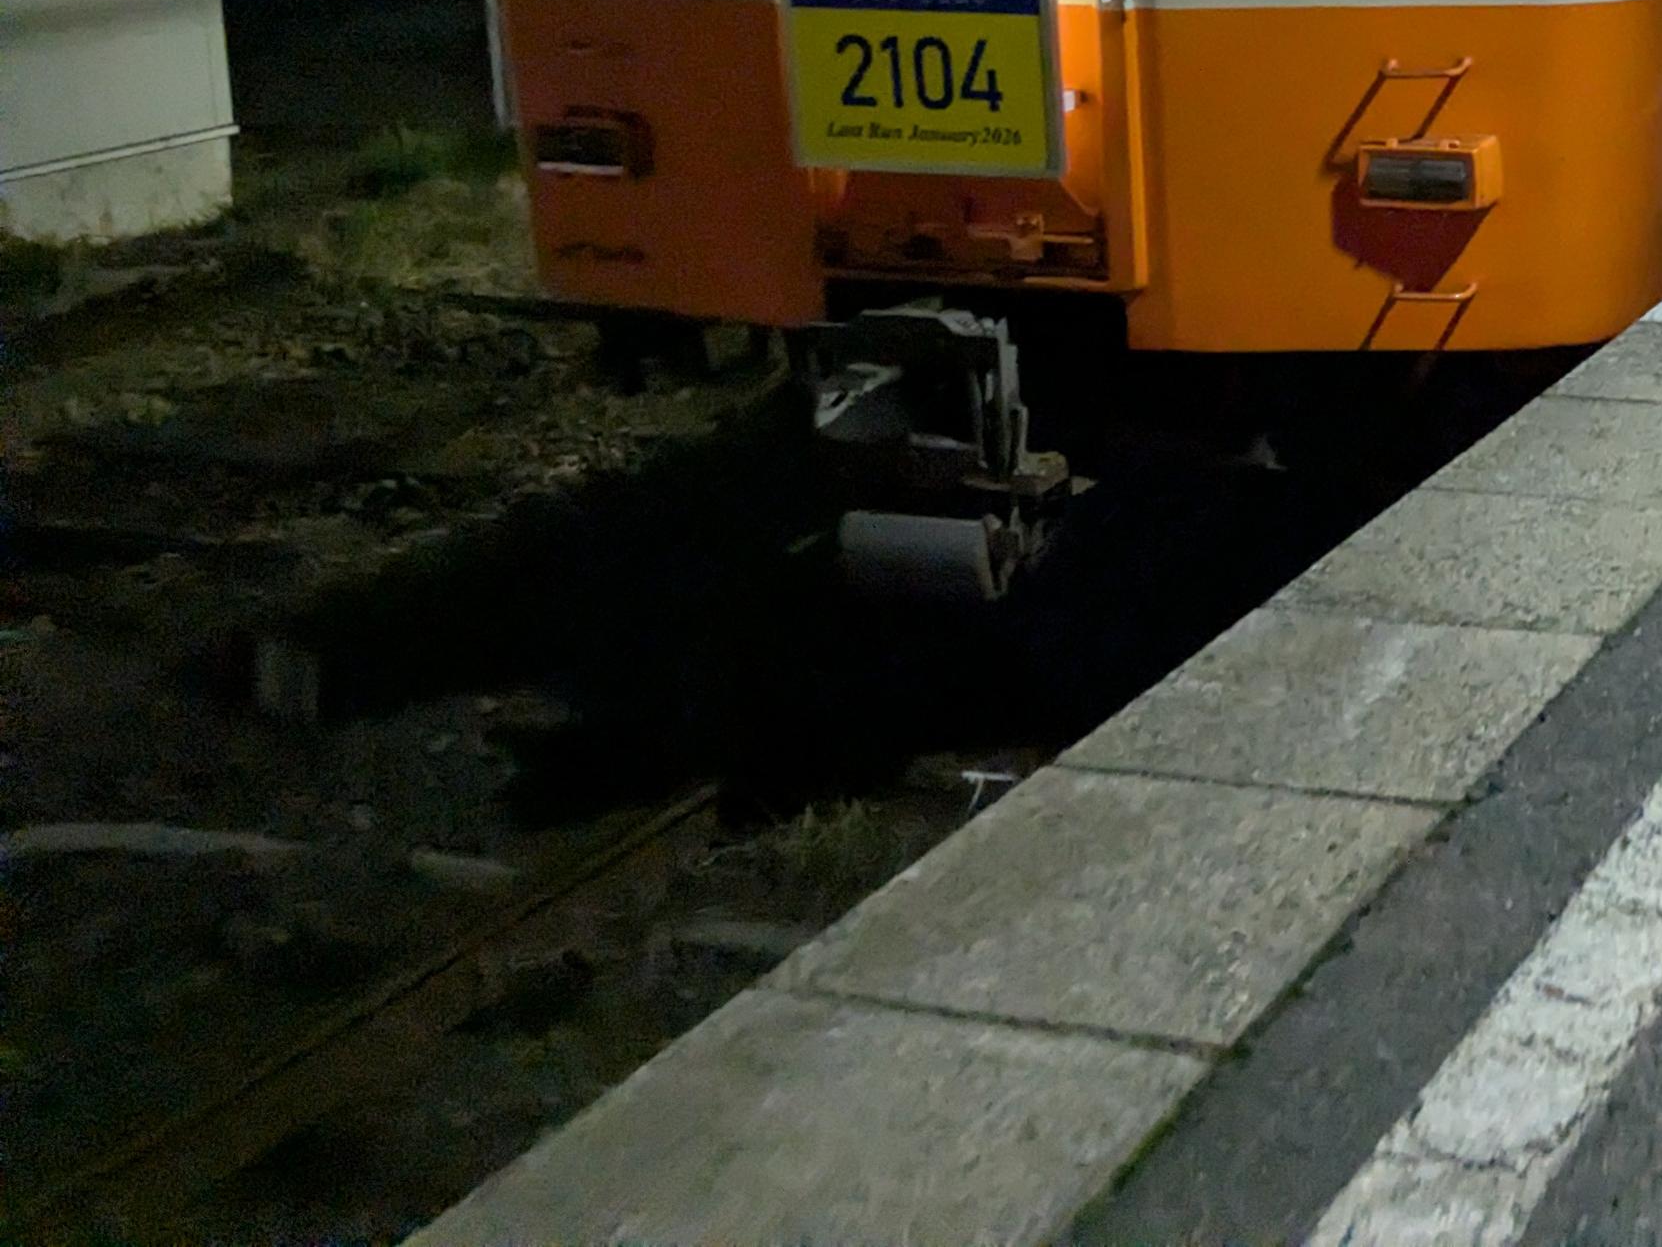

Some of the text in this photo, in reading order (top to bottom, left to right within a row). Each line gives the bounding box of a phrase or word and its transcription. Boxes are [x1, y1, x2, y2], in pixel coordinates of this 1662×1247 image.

[836, 34, 1004, 113] 2104
[826, 121, 864, 138] Last
[868, 122, 903, 139] Run
